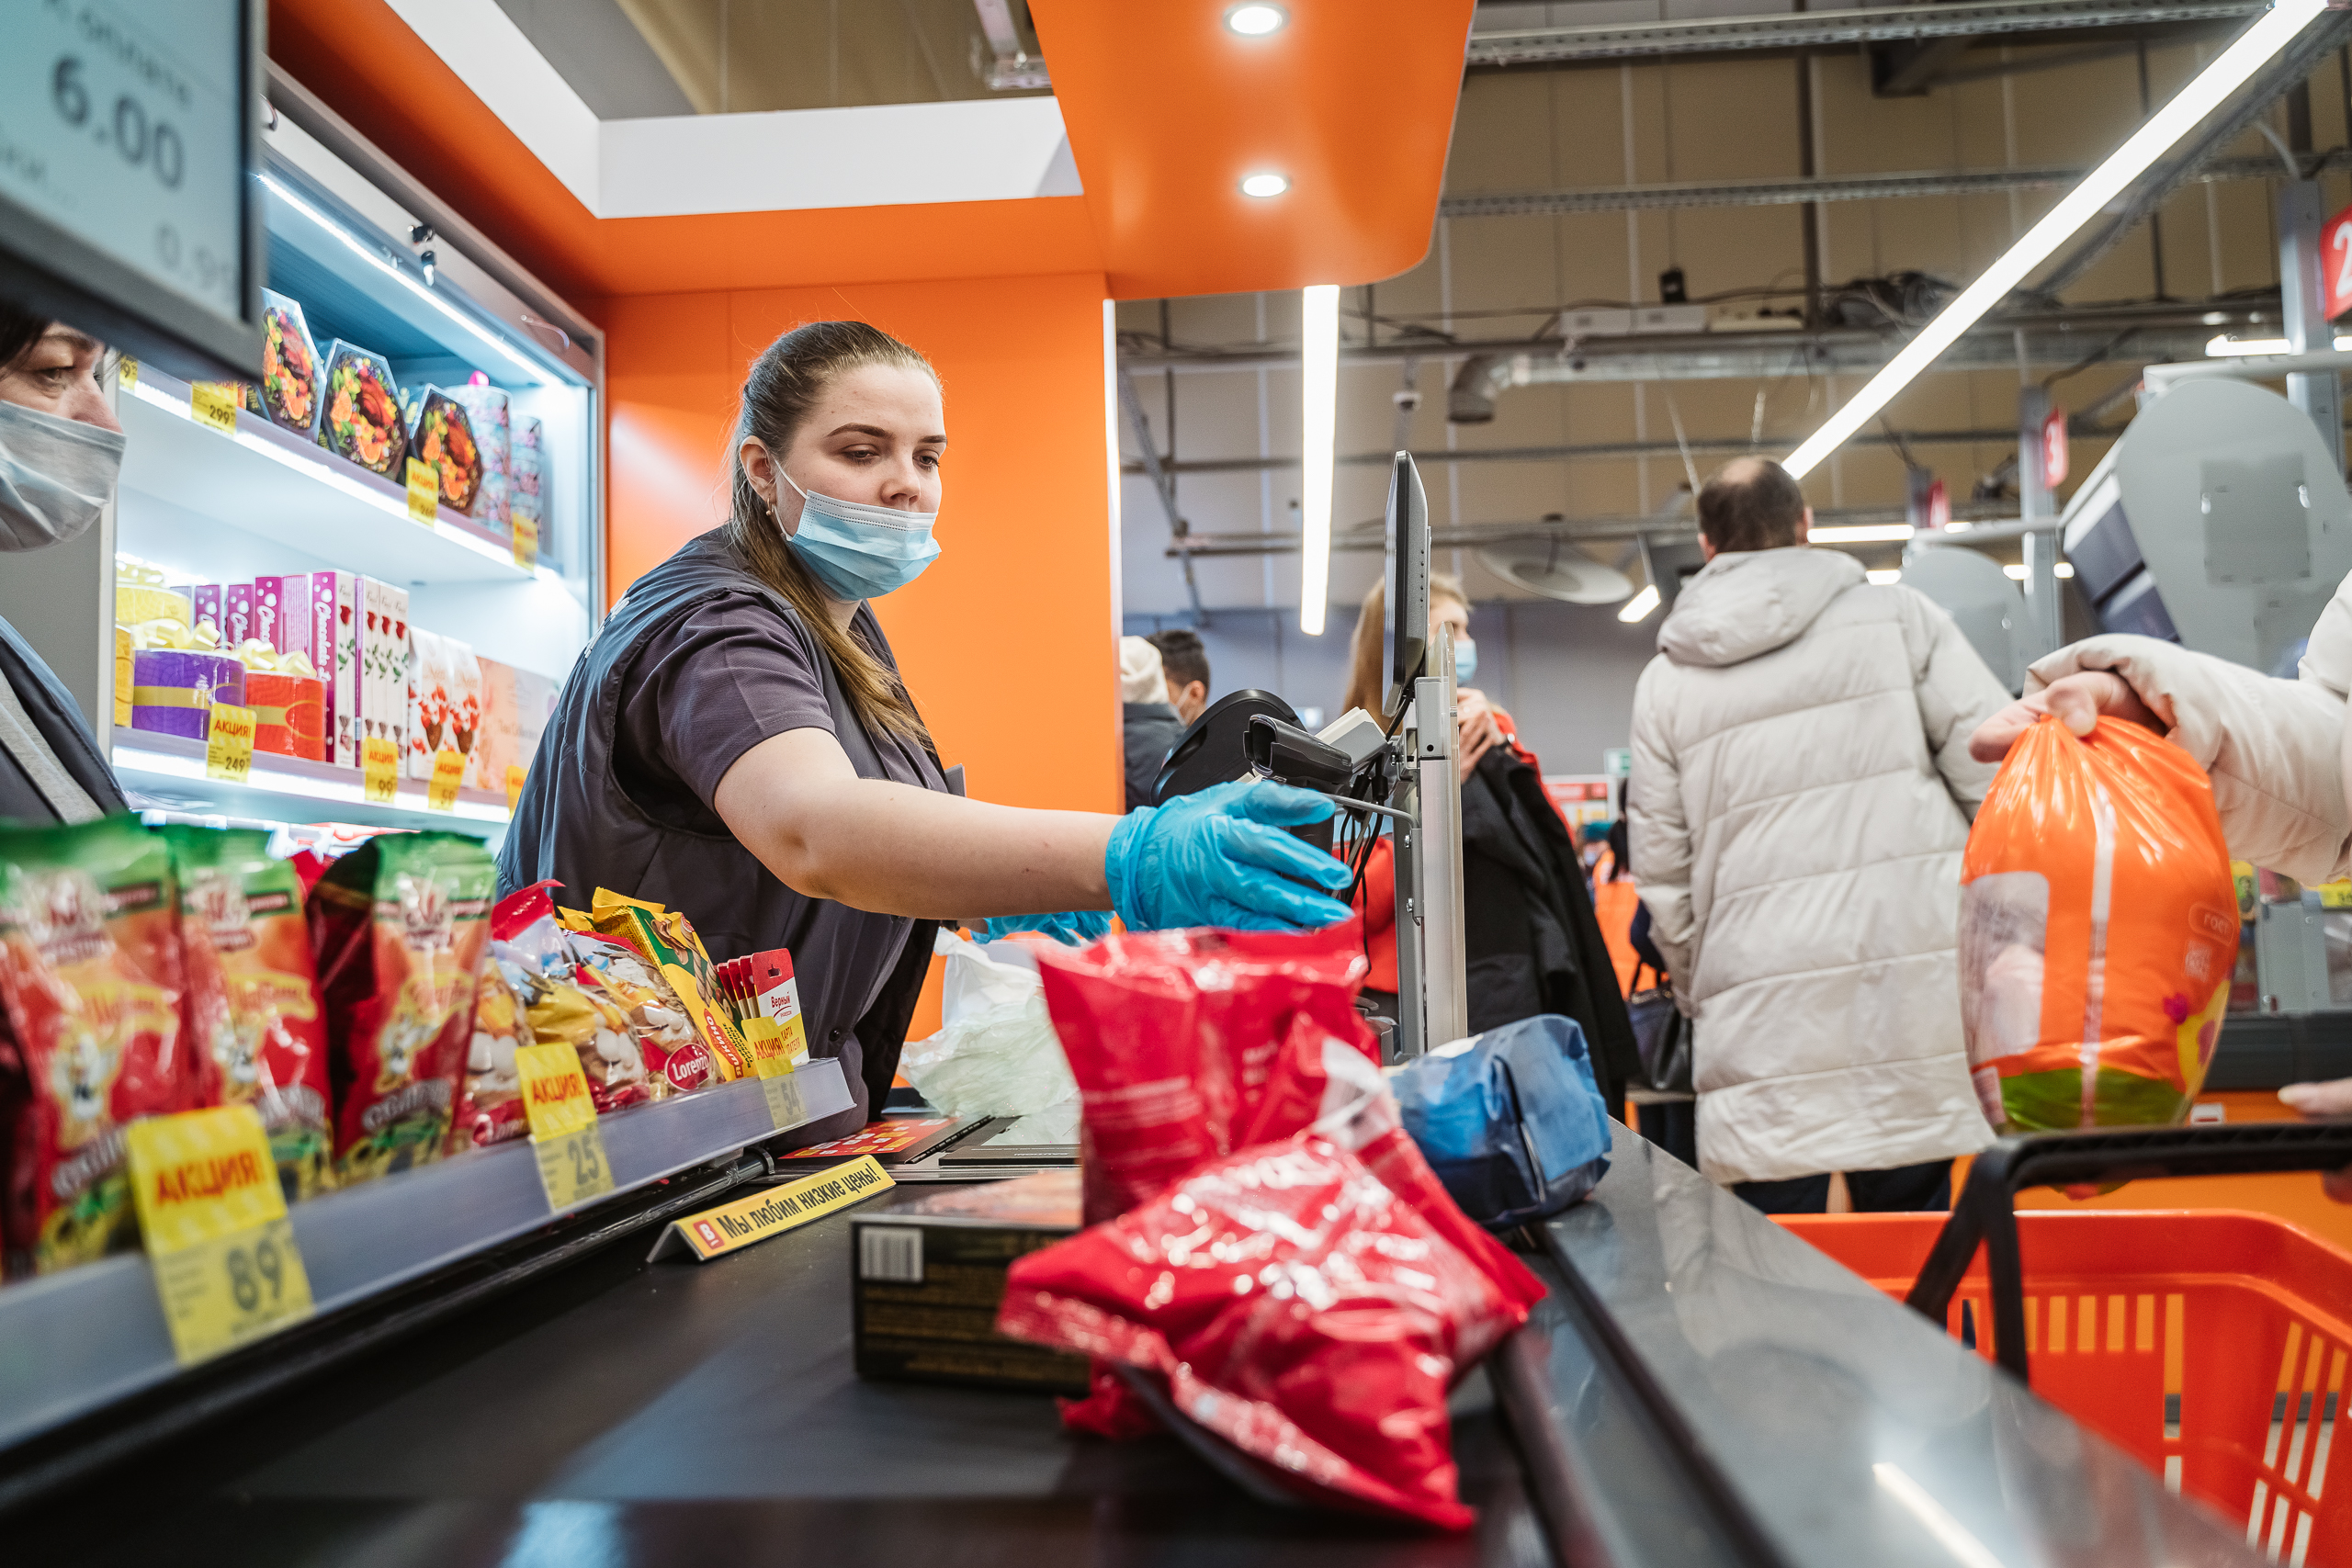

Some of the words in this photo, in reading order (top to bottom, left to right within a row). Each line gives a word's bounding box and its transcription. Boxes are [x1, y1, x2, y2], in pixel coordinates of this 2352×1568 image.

[50, 50, 187, 193] 6.00
[2333, 220, 2352, 299] 2
[209, 404, 231, 425] 299
[2045, 421, 2064, 476] 3
[314, 601, 333, 668] Chocolate
[213, 719, 251, 739] АКЦИЯ!
[225, 756, 246, 773] 249
[379, 779, 393, 797] 99
[771, 990, 791, 1009] Верный
[706, 1015, 742, 1077] ЯШКИНО
[753, 1036, 786, 1061] АКЦИЯ!
[531, 1072, 584, 1105] АКЦИЯ!
[568, 1134, 601, 1185] 25
[716, 1214, 753, 1238] Мы
[749, 1198, 803, 1229] любим
[796, 1180, 846, 1211] низкие
[841, 1162, 882, 1193] цены!
[224, 1237, 282, 1312] 89
